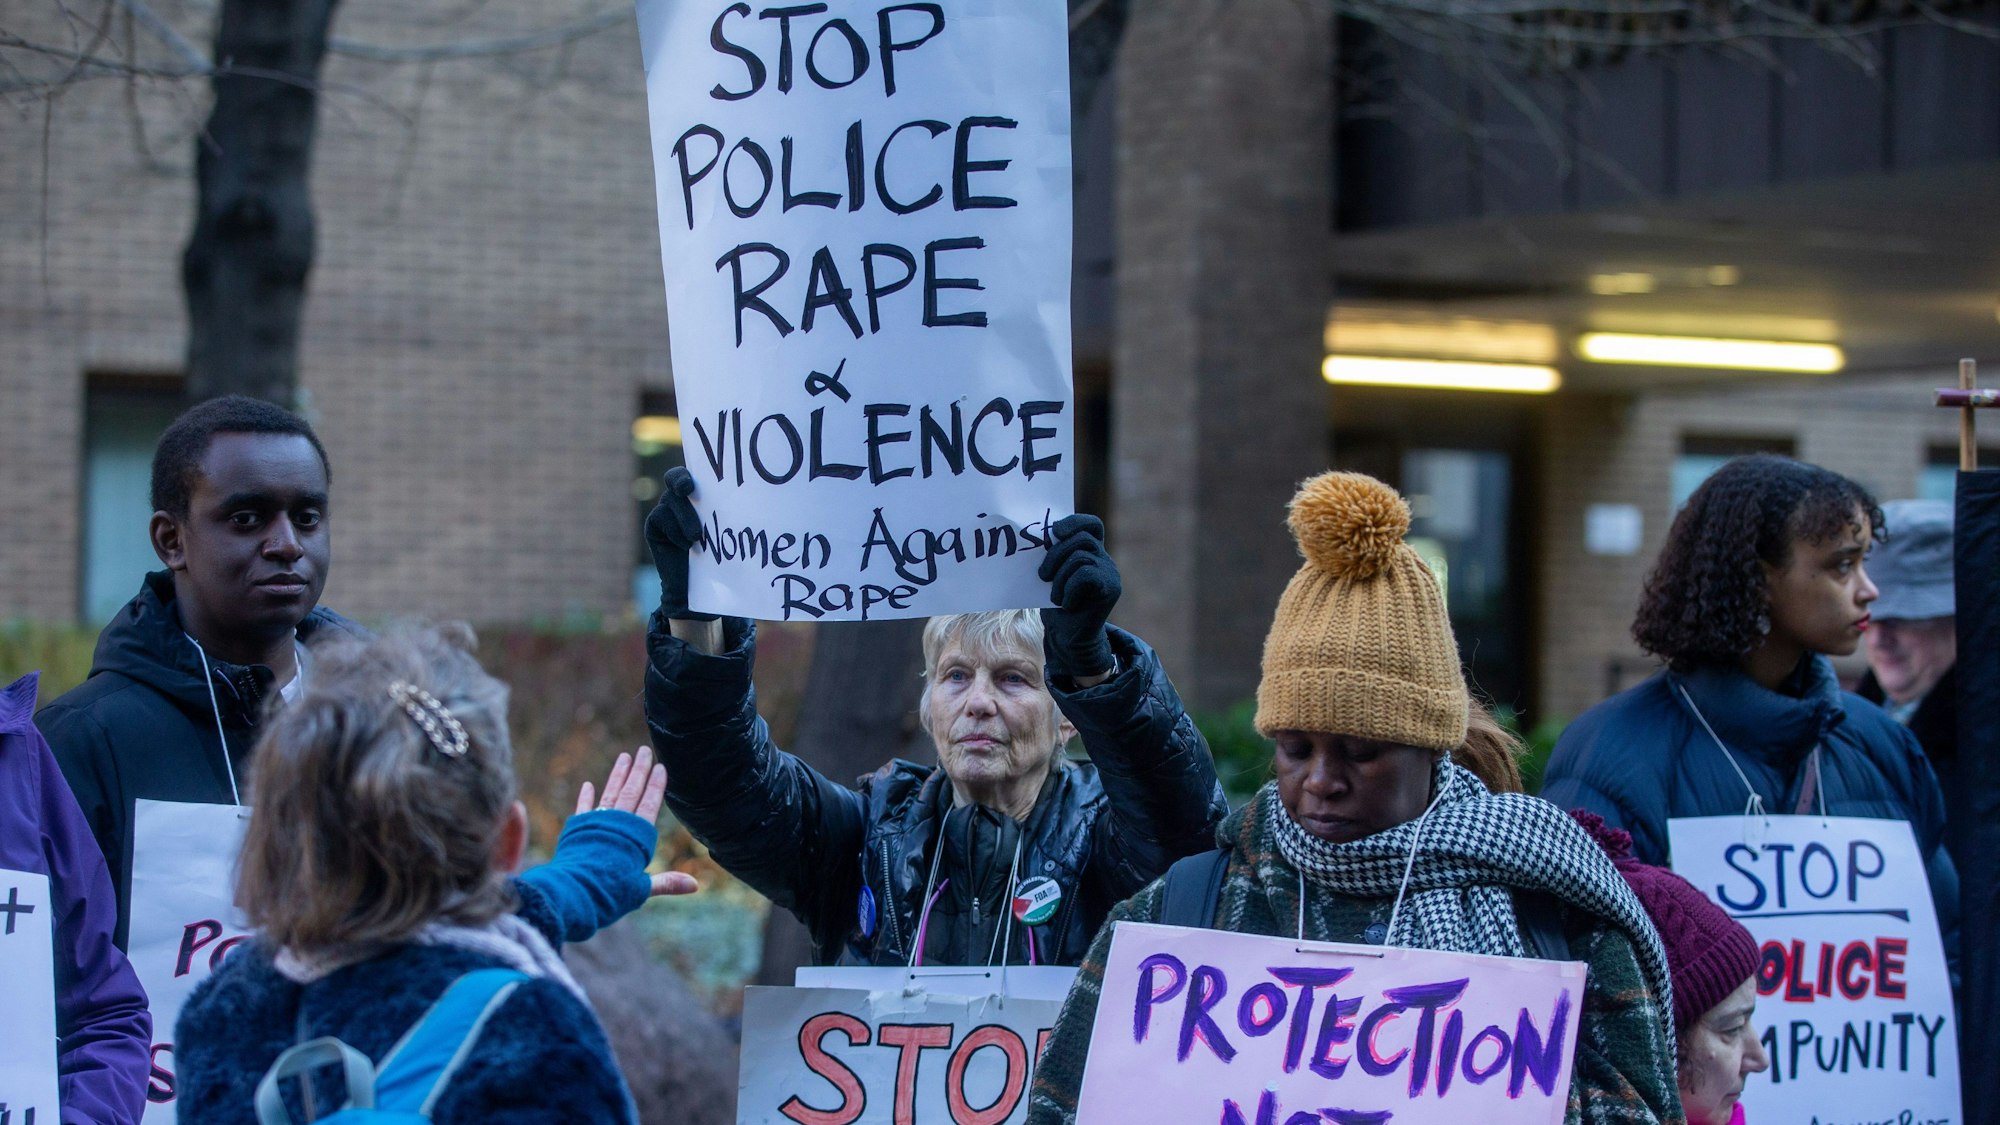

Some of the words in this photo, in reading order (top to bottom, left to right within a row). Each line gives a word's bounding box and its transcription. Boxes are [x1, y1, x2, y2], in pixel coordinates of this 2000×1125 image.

[710, 2, 945, 101] STOP
[671, 116, 1018, 231] POLICE
[715, 236, 989, 349] RAPE
[693, 396, 1065, 487] VIOLENCE
[699, 509, 831, 570] Women
[860, 506, 1054, 586] Against
[770, 573, 919, 621] Rape
[1034, 890, 1048, 903] FOA
[1716, 840, 1885, 911] STOP
[1756, 937, 1908, 1002] OLICE
[778, 1011, 1053, 1125] STO
[1134, 953, 1571, 1099] PROTECTION
